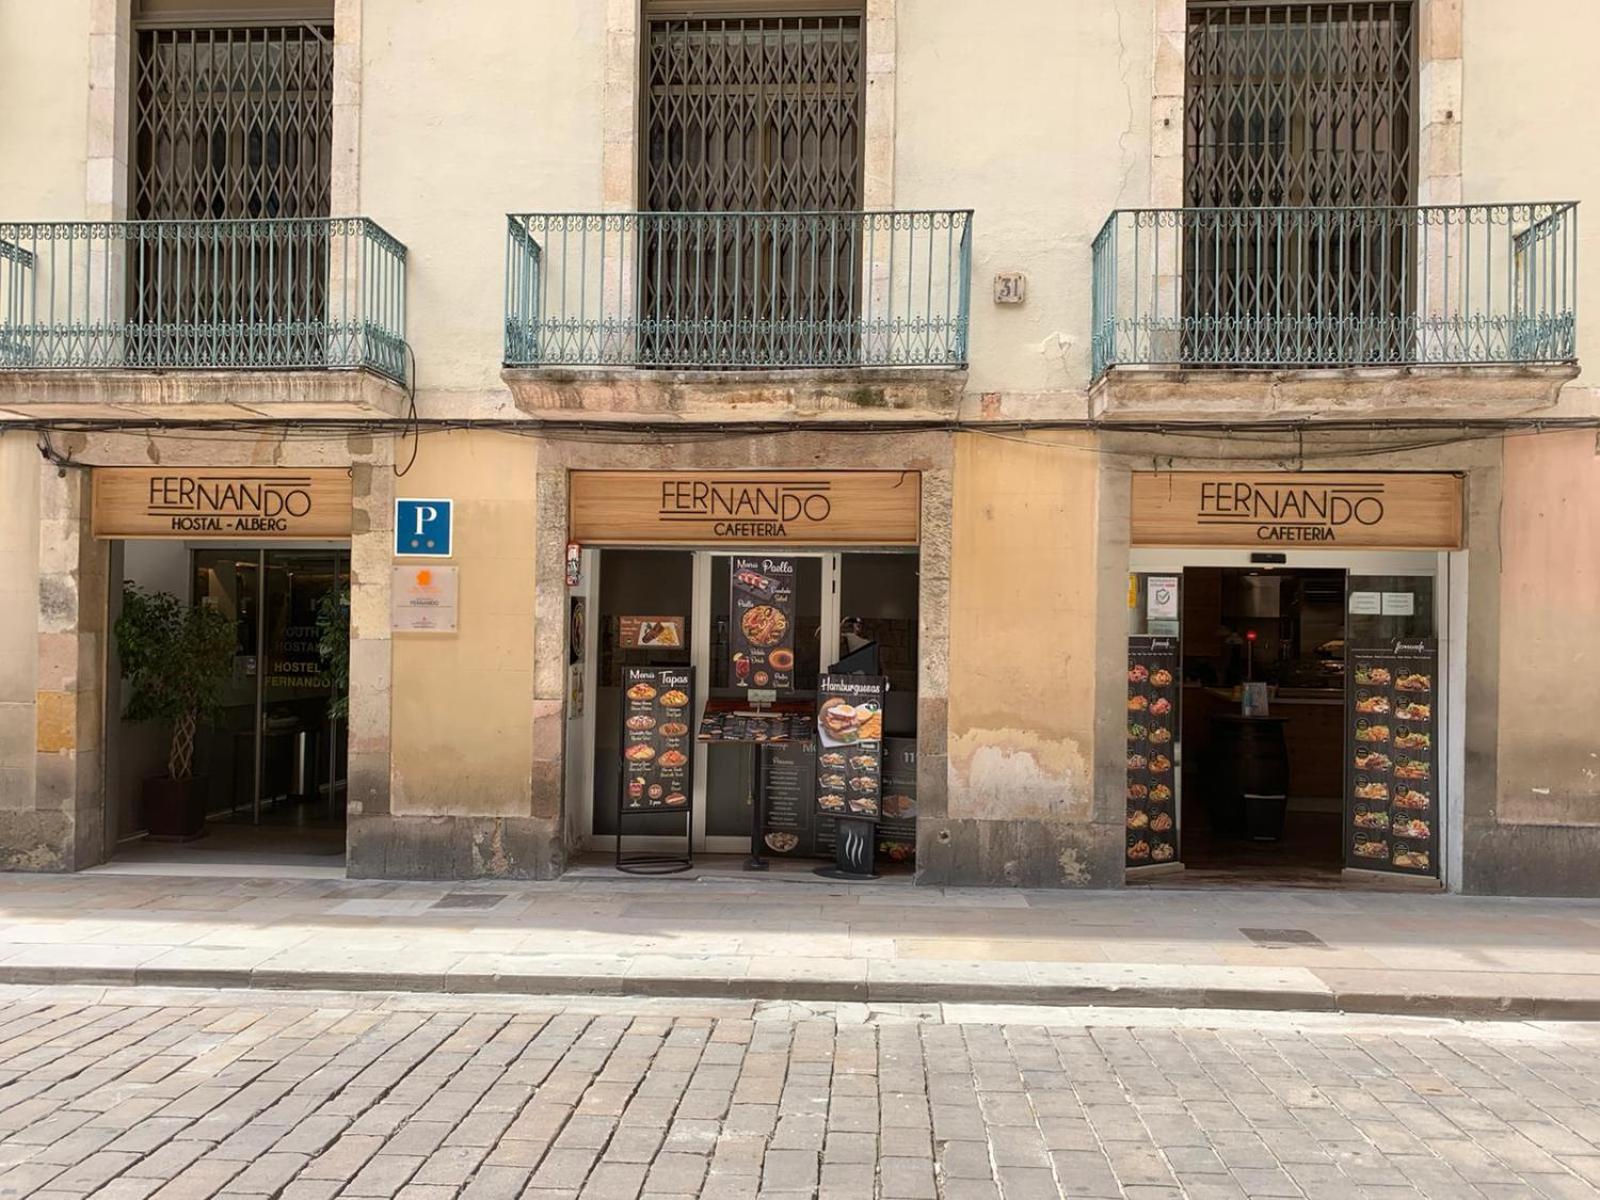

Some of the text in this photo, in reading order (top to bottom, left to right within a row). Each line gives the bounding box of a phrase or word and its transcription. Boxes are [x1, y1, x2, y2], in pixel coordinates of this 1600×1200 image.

[1000, 278, 1018, 297] 31
[150, 477, 311, 517] FERNANDO
[662, 481, 831, 521] FERNANDO
[1201, 483, 1384, 525] FERNANDO
[172, 518, 222, 530] HOSTAL
[235, 518, 287, 531] ALBERG
[414, 506, 437, 535] P
[714, 523, 787, 536] CAFETERIA
[1257, 526, 1335, 541] CAFETERIA
[763, 559, 793, 574] Paella
[274, 662, 321, 673] HOSTEL
[658, 671, 688, 687] Tapas
[820, 677, 880, 696] Hamburguesas
